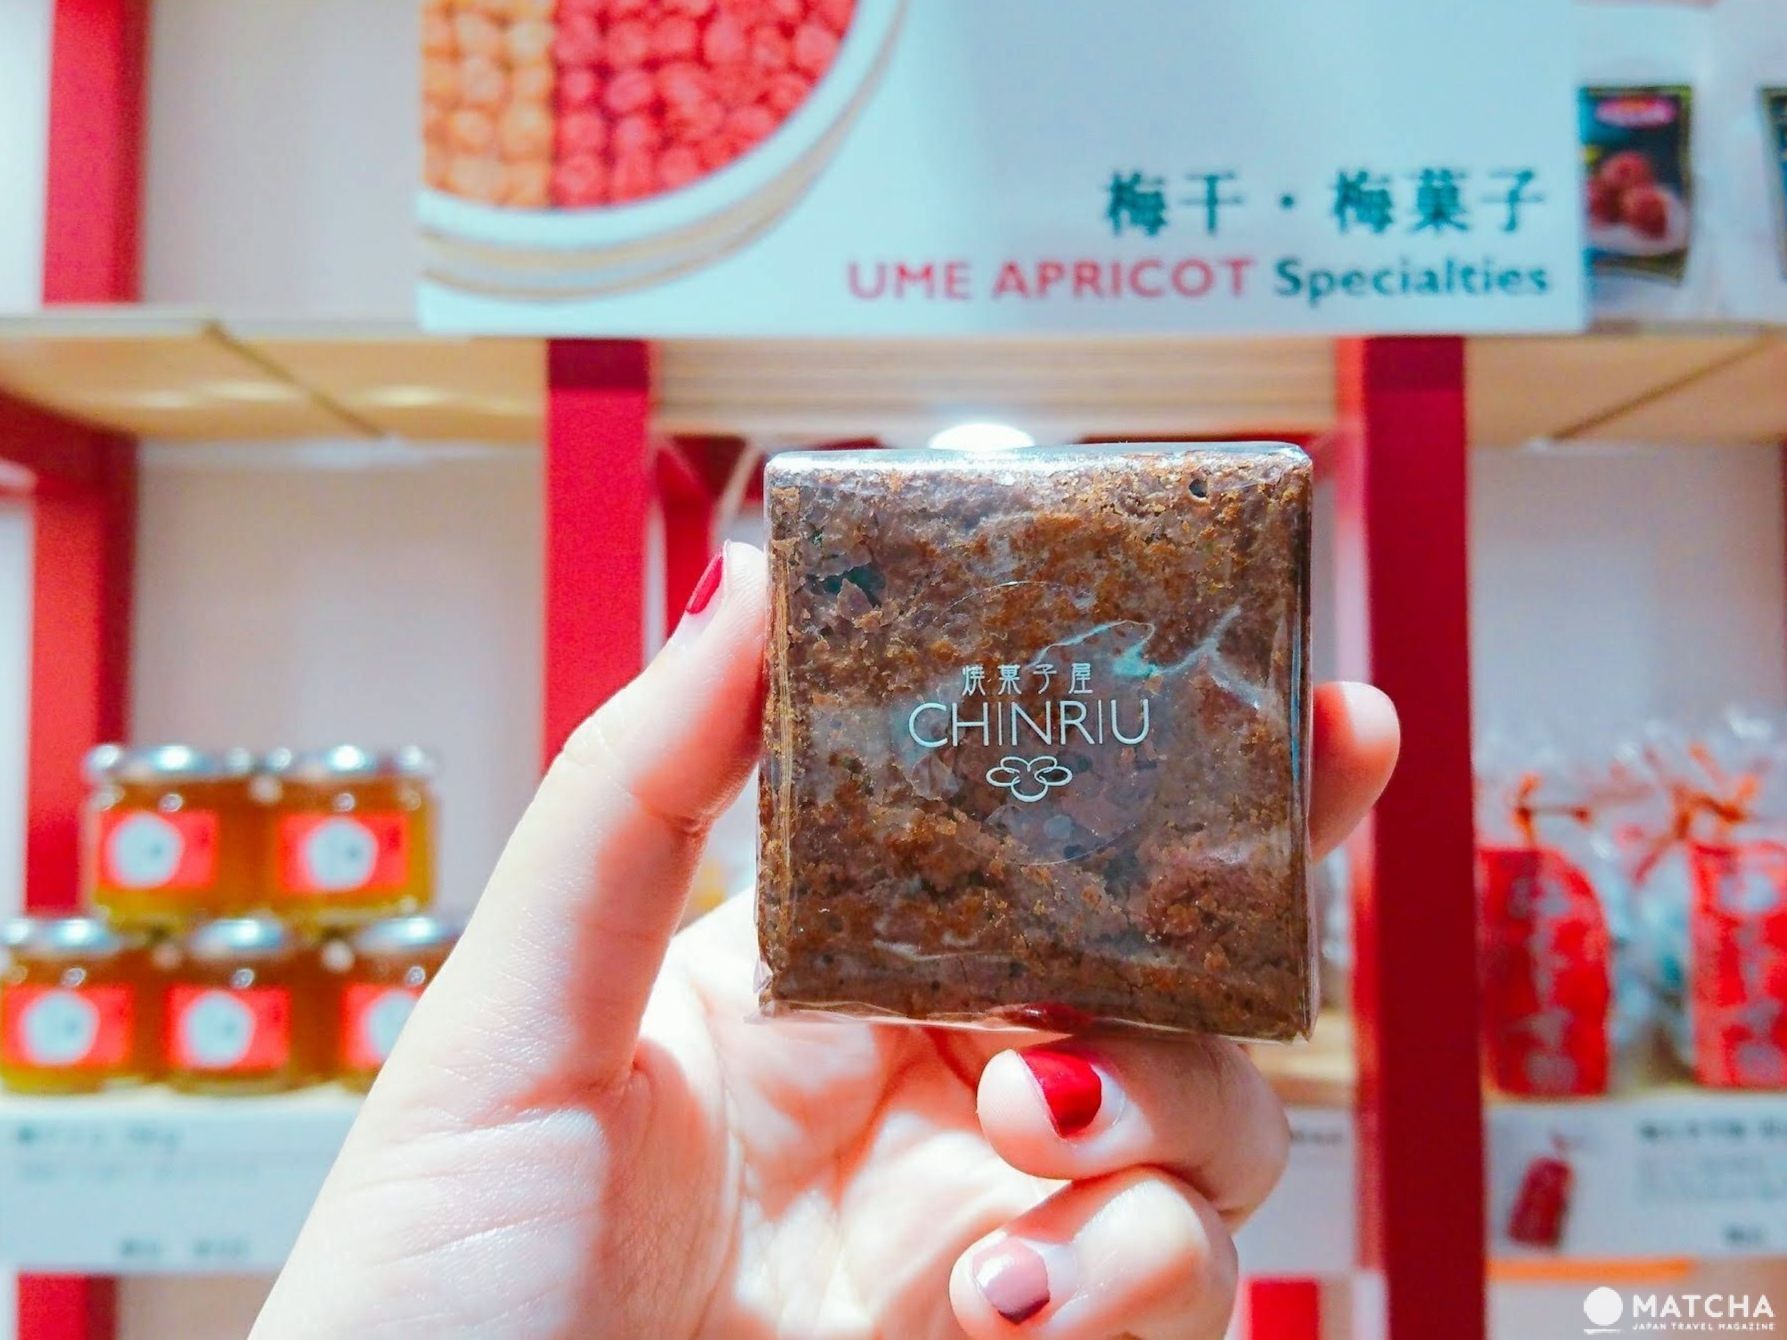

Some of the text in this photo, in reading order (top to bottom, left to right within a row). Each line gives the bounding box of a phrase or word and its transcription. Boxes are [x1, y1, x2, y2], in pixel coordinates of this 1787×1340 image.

[1106, 168, 1547, 237] 梅干・梅菓子
[847, 256, 1550, 306] UME APRICOT Specialties
[961, 662, 1094, 697] 焼菓子屋
[908, 698, 1150, 748] CHINRIU
